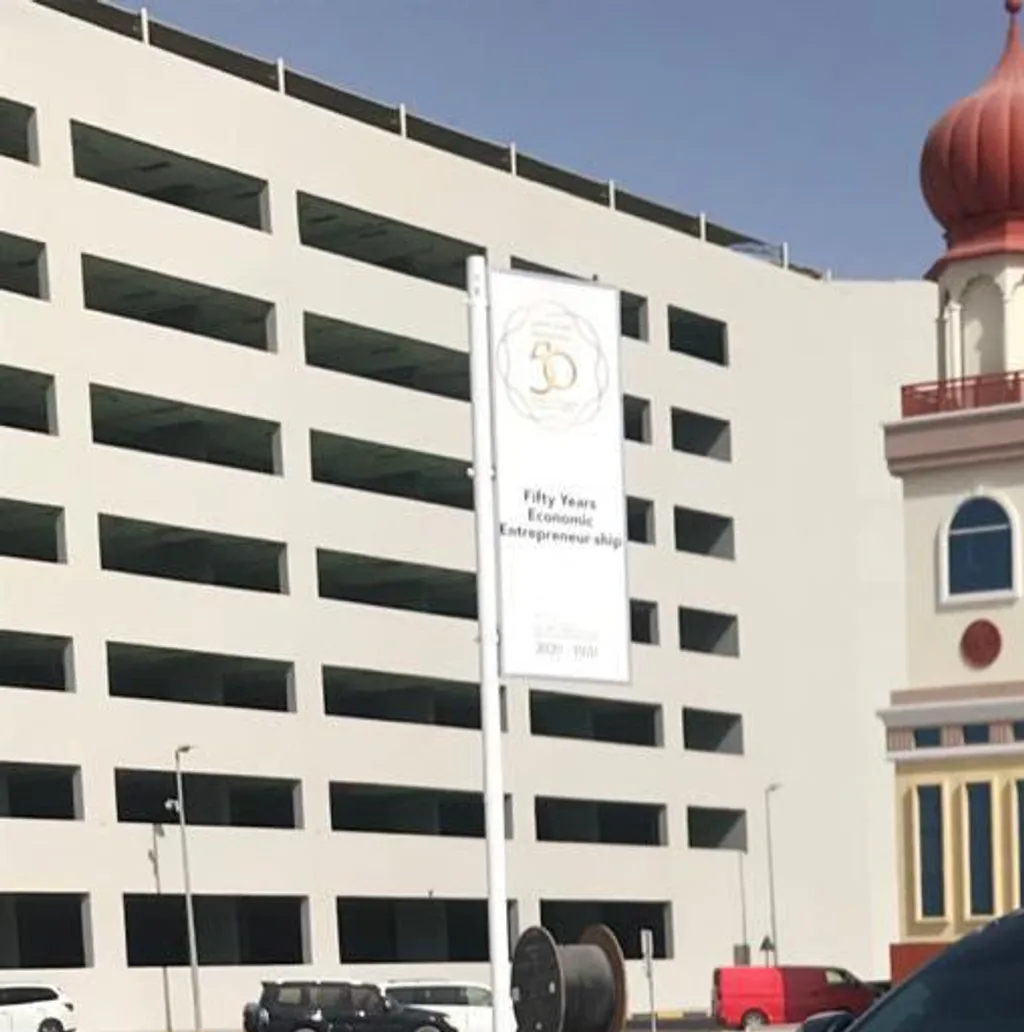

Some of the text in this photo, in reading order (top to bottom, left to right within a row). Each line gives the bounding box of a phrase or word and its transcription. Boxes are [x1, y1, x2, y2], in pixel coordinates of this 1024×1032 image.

[524, 489, 597, 510] Fifty Years
[527, 507, 594, 528] Economic
[499, 522, 590, 544] Entrepreneur
